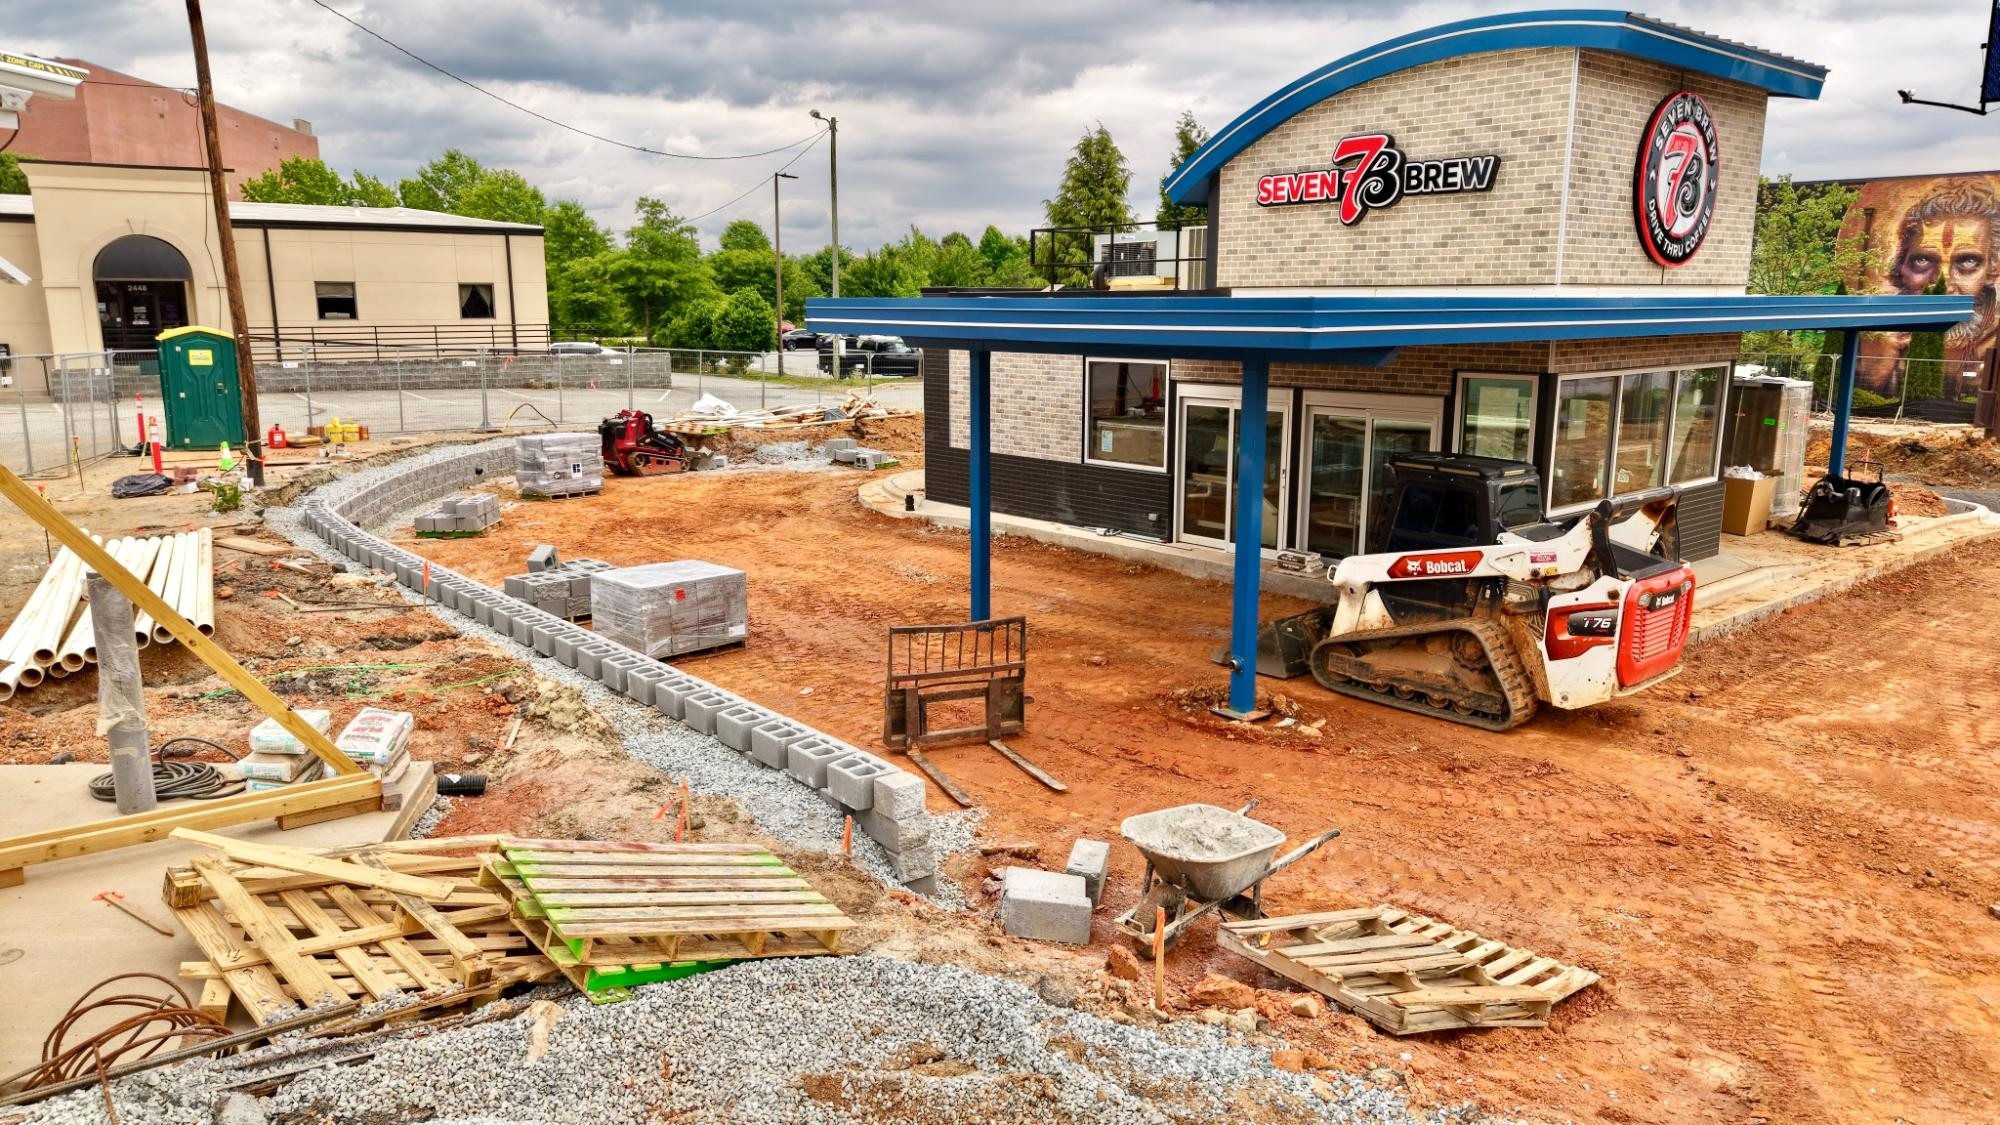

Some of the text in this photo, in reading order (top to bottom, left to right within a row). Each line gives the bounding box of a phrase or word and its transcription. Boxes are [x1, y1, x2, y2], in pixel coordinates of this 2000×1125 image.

[6, 56, 27, 67] ZONE
[28, 61, 45, 71] CAM
[1655, 101, 1717, 161] SEVEN BREW
[1257, 170, 1339, 204] SEVEN
[1403, 155, 1495, 194] BREW
[1648, 198, 1711, 257] DRIVE THRU COFFEE
[1426, 559, 1467, 574] Bobcat
[1583, 617, 1612, 629] T76
